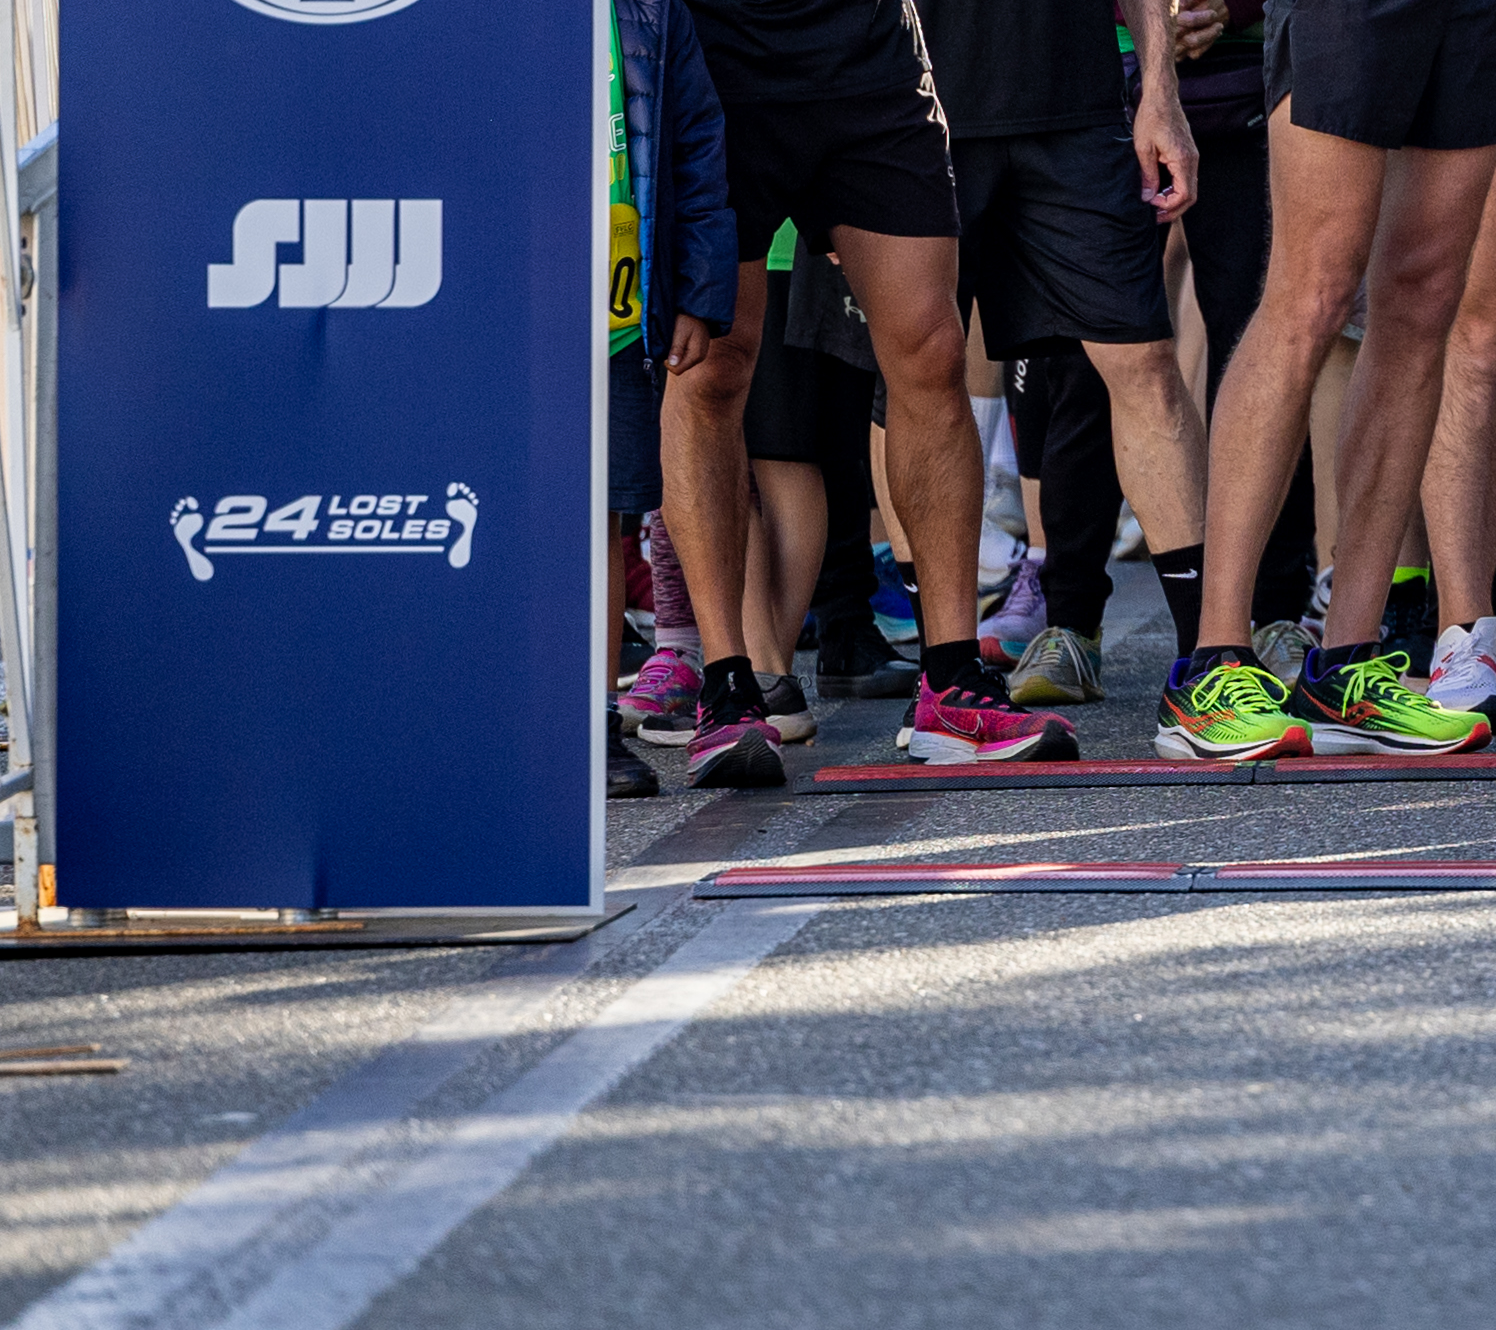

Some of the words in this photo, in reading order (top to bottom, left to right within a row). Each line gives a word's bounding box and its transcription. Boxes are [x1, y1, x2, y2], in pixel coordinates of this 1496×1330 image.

[205, 495, 323, 540] 24
[328, 495, 429, 516] LOST
[328, 520, 451, 540] SOLES
